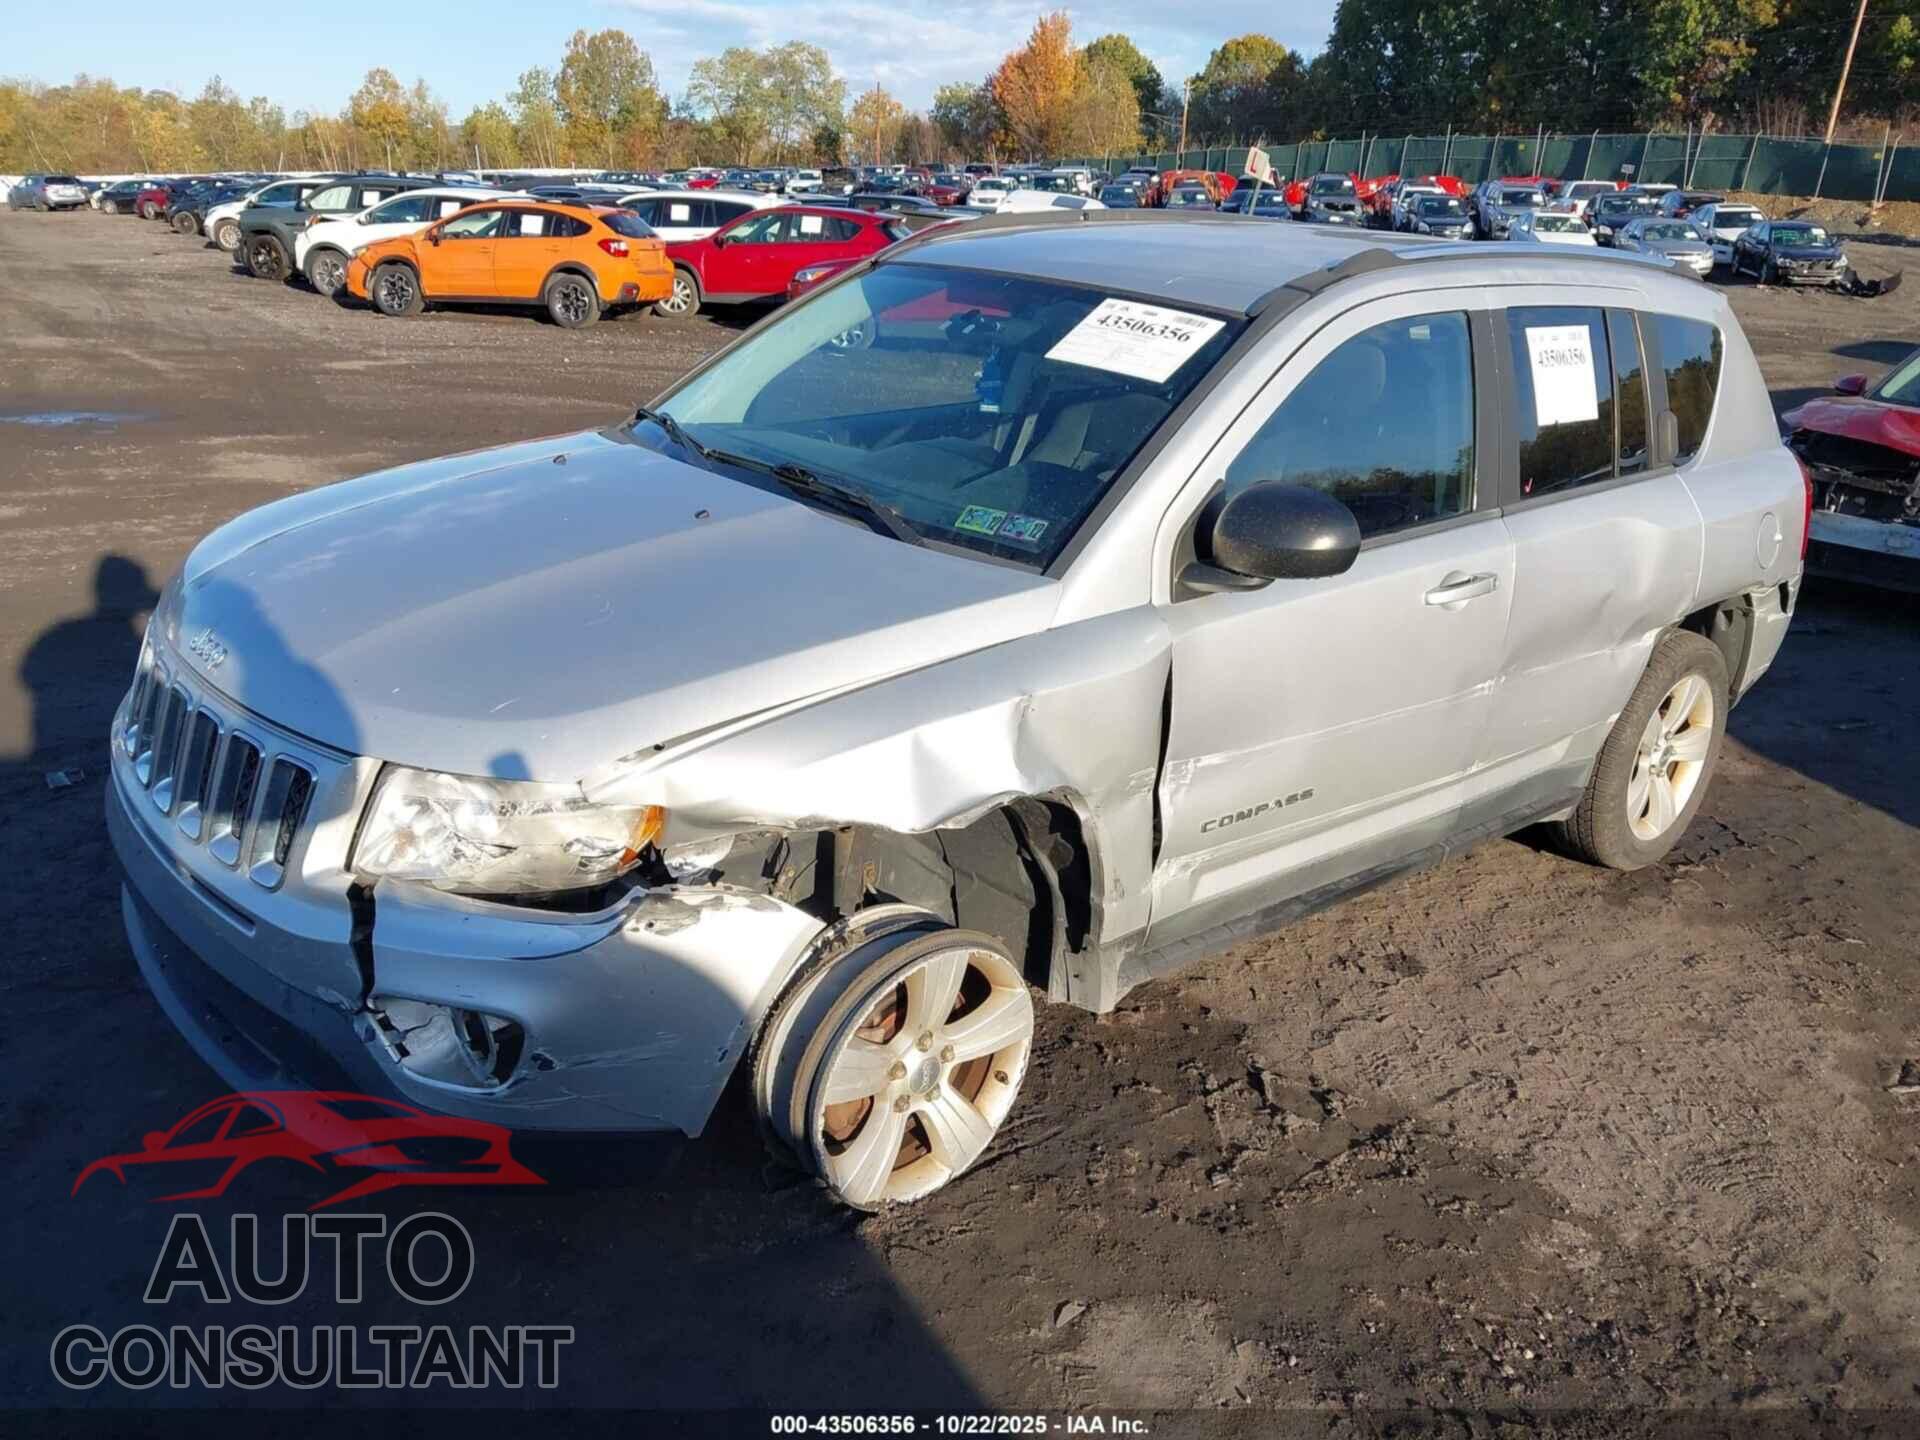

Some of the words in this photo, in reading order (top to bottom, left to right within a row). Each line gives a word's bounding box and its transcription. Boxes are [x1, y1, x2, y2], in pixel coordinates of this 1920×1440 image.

[1097, 314, 1192, 342] 43506356
[1538, 348, 1586, 368] 43506356
[1200, 787, 1315, 833] COMPASS
